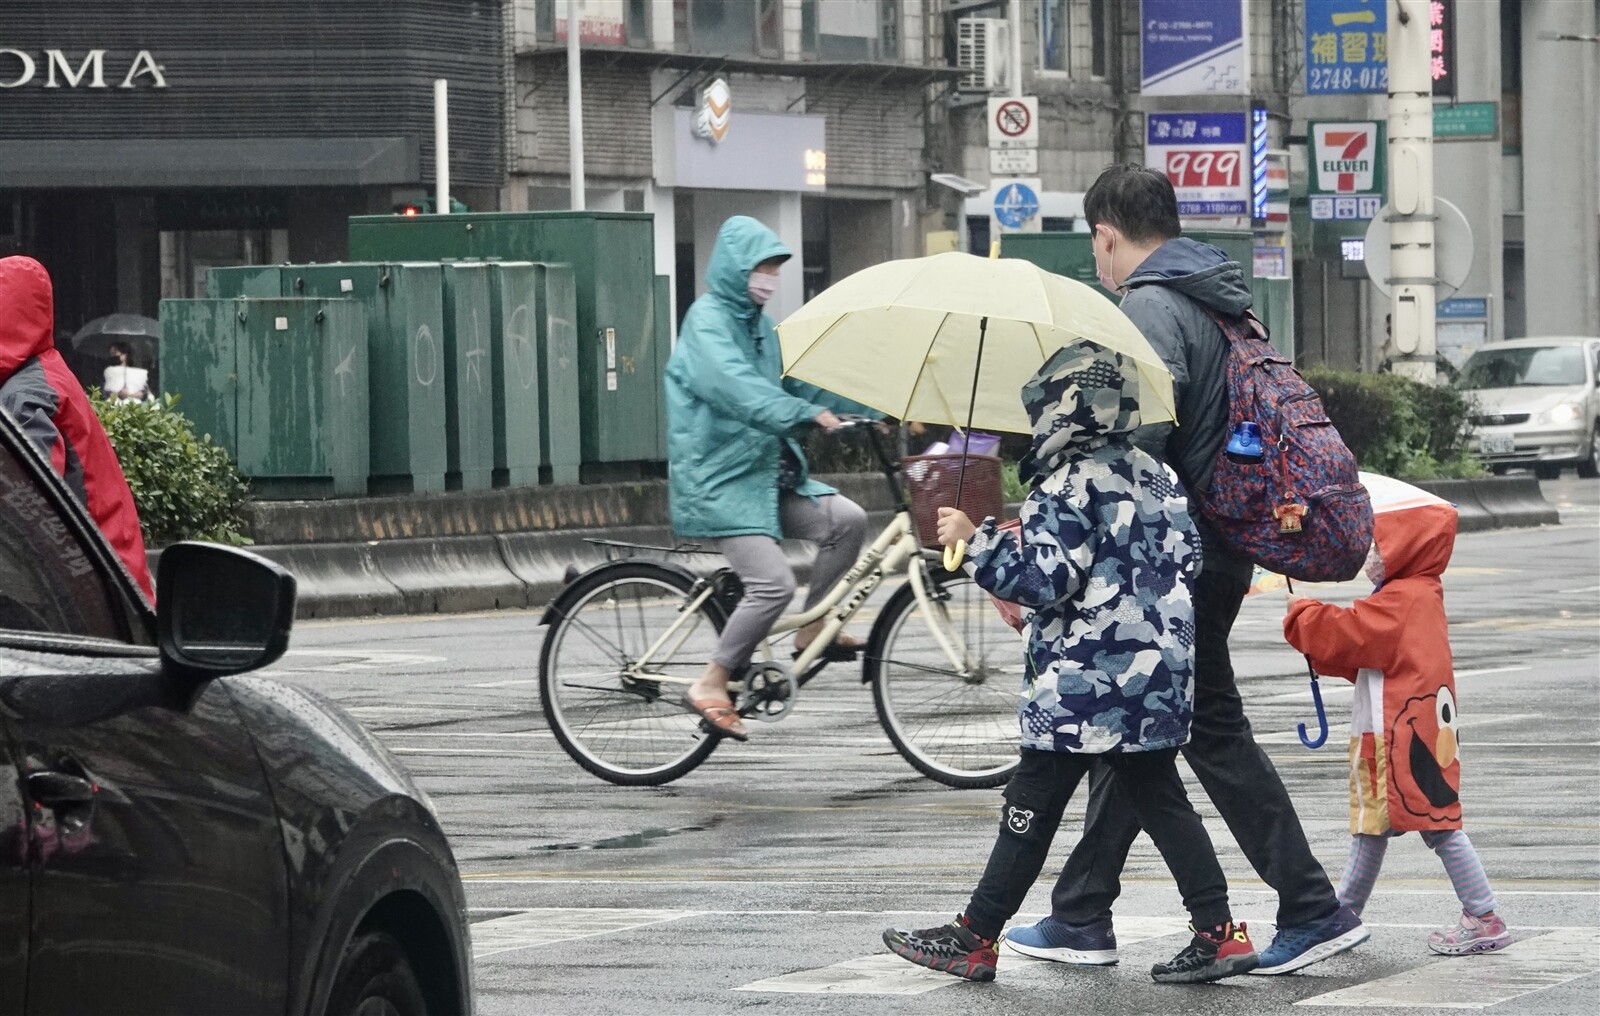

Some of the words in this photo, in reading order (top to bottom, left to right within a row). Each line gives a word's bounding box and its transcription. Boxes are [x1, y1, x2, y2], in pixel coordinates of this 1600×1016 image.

[0, 48, 171, 89] OMA
[1225, 80, 1240, 90] 2F
[1168, 152, 1240, 187] 999
[1324, 131, 1368, 191] 7
